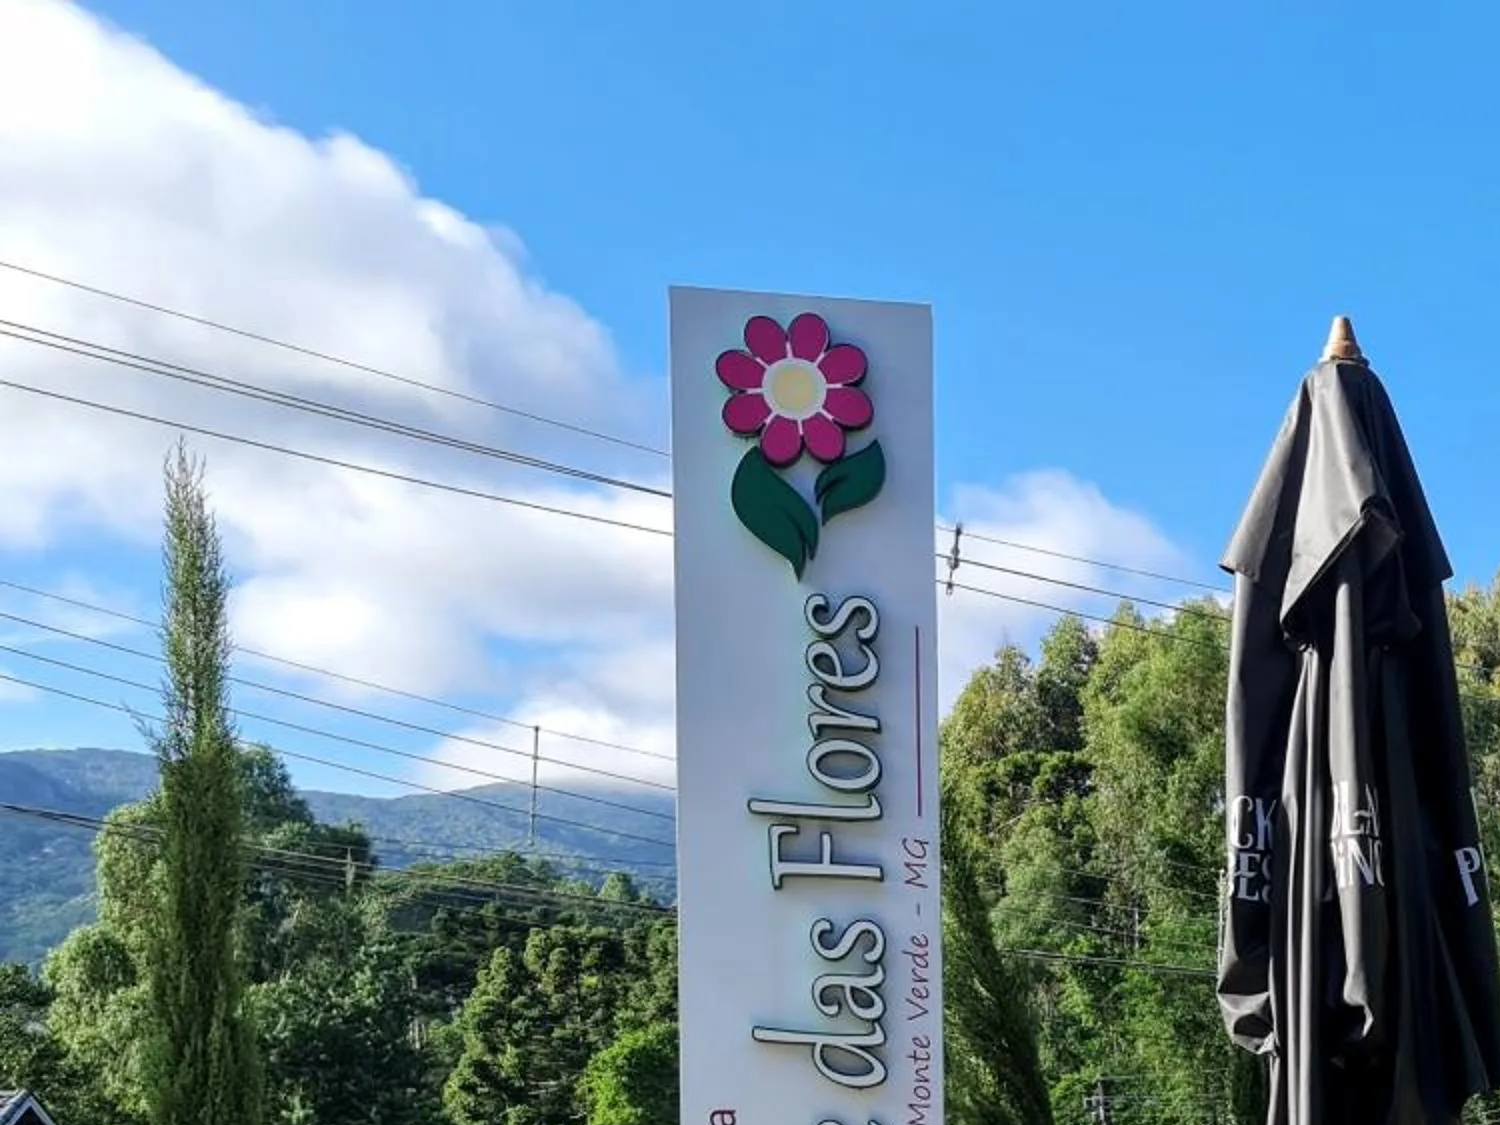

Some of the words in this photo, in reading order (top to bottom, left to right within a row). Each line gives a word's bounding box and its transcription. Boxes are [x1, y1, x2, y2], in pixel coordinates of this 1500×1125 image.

[746, 592, 885, 891] Flores
[902, 837, 929, 889] MG
[751, 916, 888, 1090] das
[903, 932, 930, 1021] Verde
